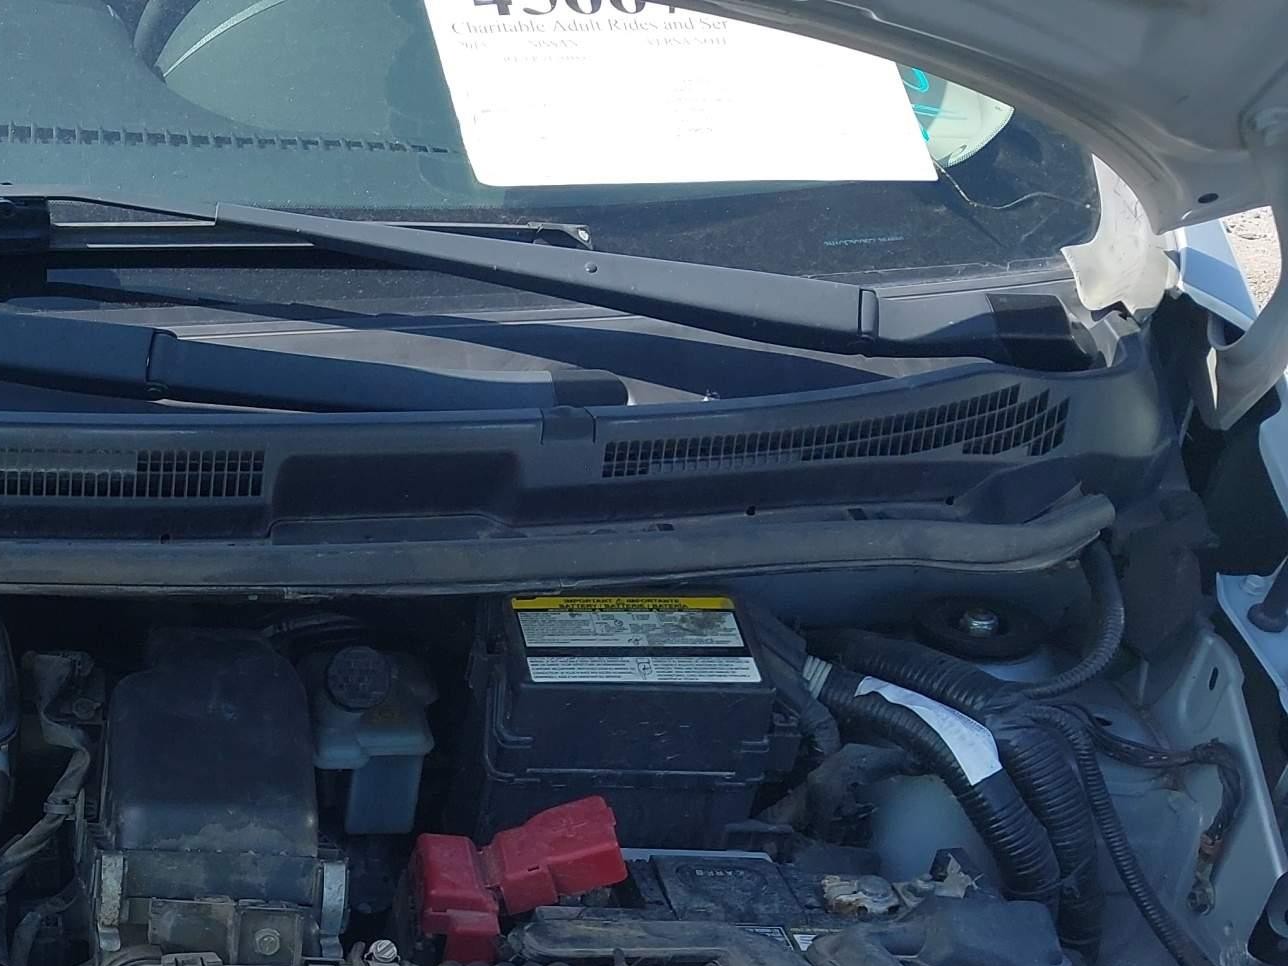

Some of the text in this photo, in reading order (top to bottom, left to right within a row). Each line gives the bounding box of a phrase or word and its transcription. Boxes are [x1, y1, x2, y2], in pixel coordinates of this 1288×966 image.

[451, 19, 545, 34] Charitable
[553, 18, 601, 32] Adult
[608, 17, 659, 31] Rides
[664, 17, 694, 31] and
